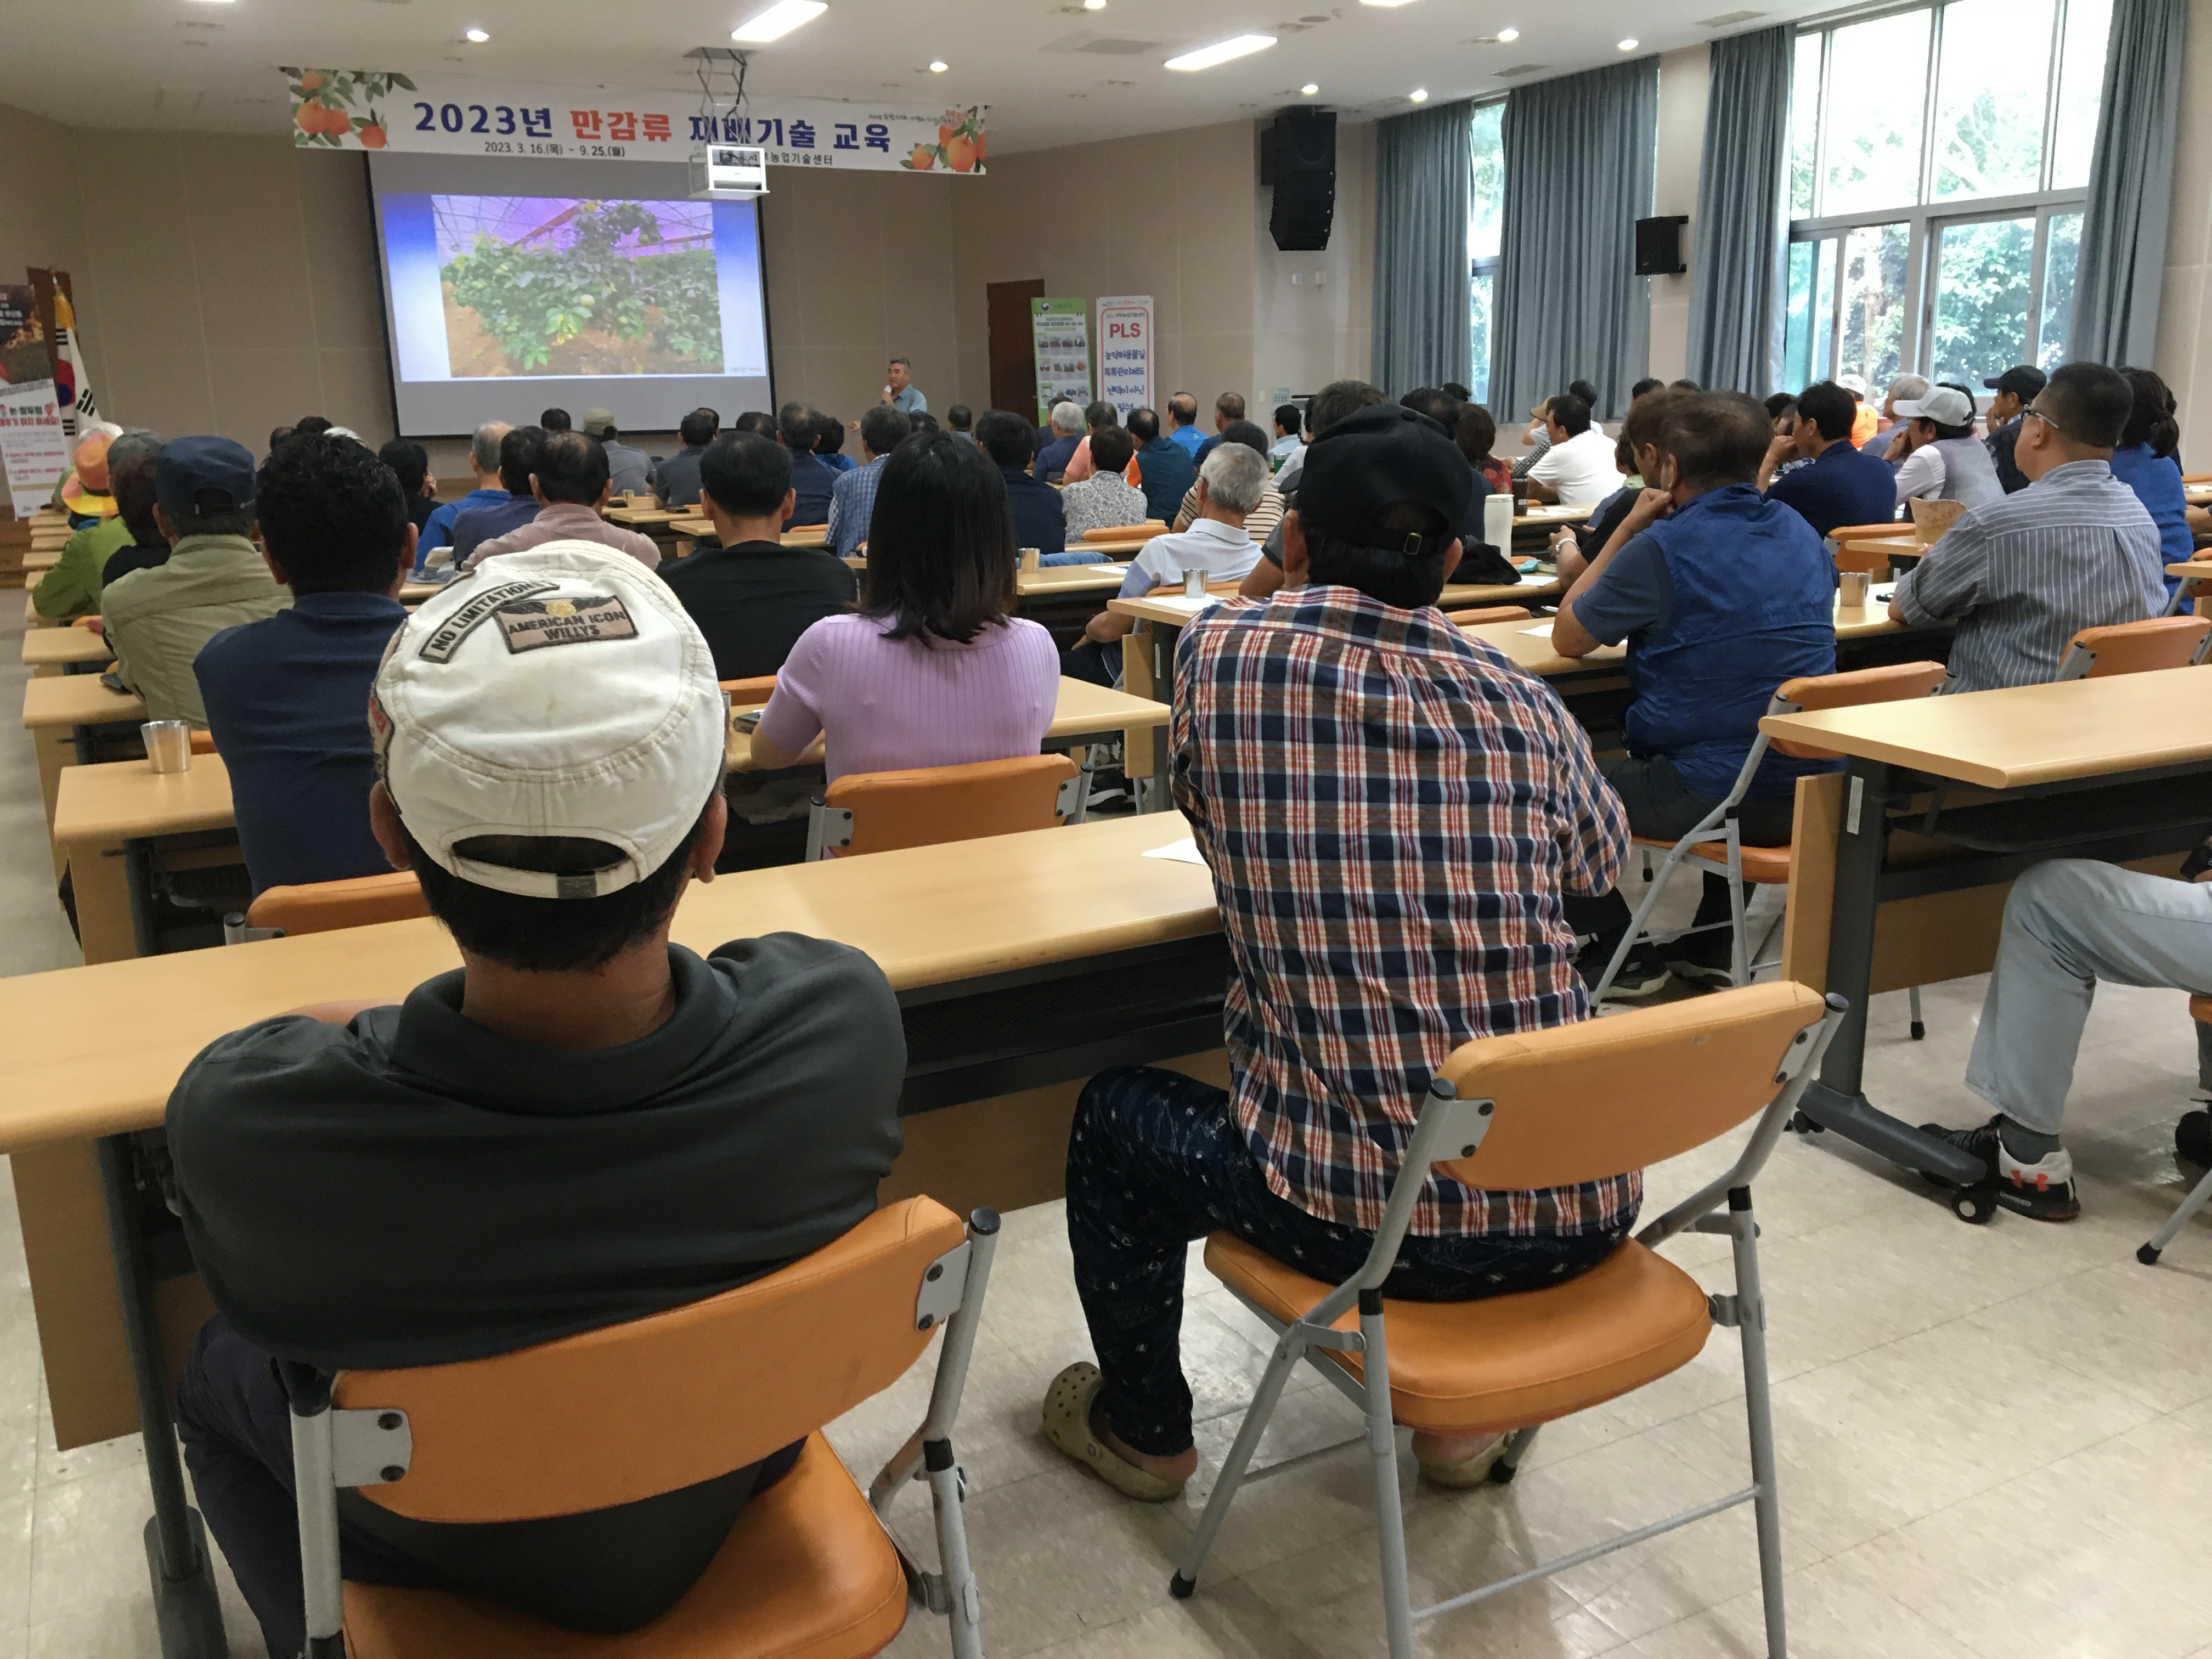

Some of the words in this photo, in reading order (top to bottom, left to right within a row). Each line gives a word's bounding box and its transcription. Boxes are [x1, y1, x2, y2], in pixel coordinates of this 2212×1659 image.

[414, 102, 552, 138] 2023년
[569, 110, 672, 142] 만감류
[689, 116, 816, 149] 재배기술
[833, 123, 890, 153] 교육
[484, 142, 514, 153] 2023.
[517, 143, 527, 154] 3.
[531, 143, 563, 155] 16.(목)
[579, 145, 590, 156] 9.
[1109, 323, 1141, 338] PLS
[1129, 385, 1145, 394] 아닌
[431, 629, 456, 652] NO
[450, 580, 544, 629] LIMITATIONS
[507, 614, 583, 635] AMERICAN
[589, 611, 627, 624] ICON
[543, 624, 600, 641] WILLYS
